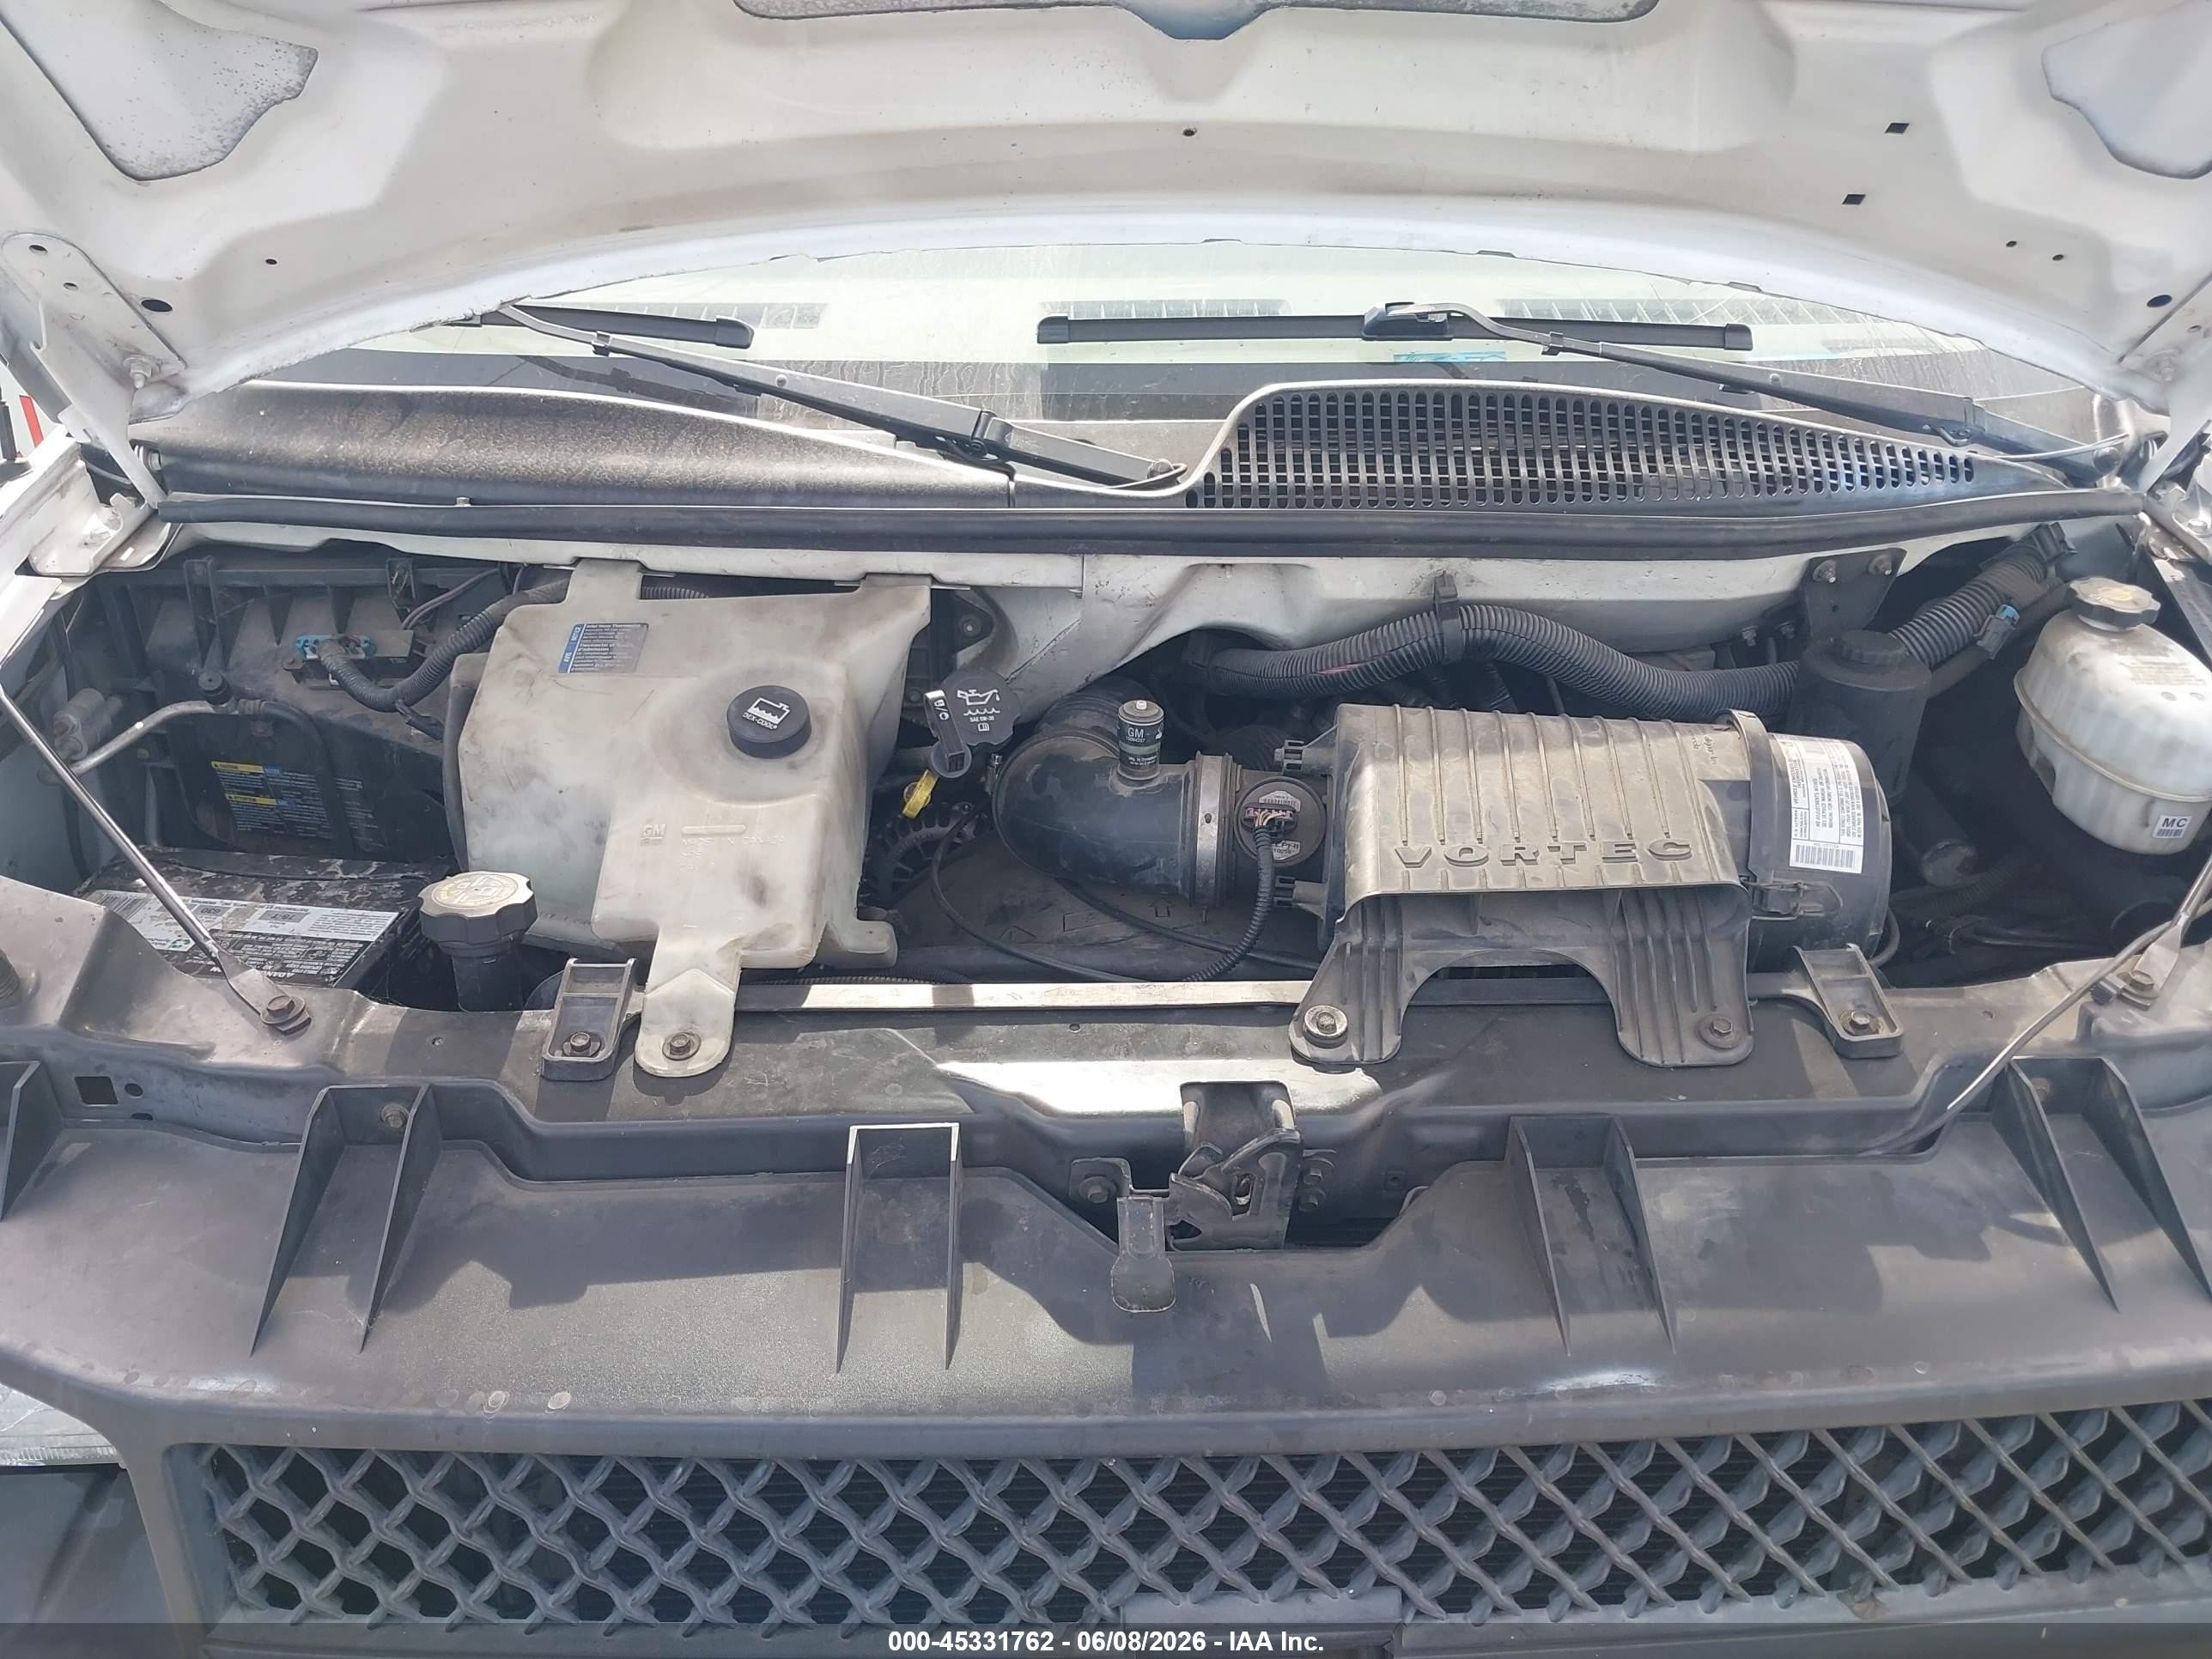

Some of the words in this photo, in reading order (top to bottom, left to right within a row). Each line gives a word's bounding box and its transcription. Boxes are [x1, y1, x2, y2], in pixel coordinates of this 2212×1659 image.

[1127, 727, 1145, 738] GM
[2162, 817, 2188, 827] MC
[1395, 839, 1692, 868] VORTEC
